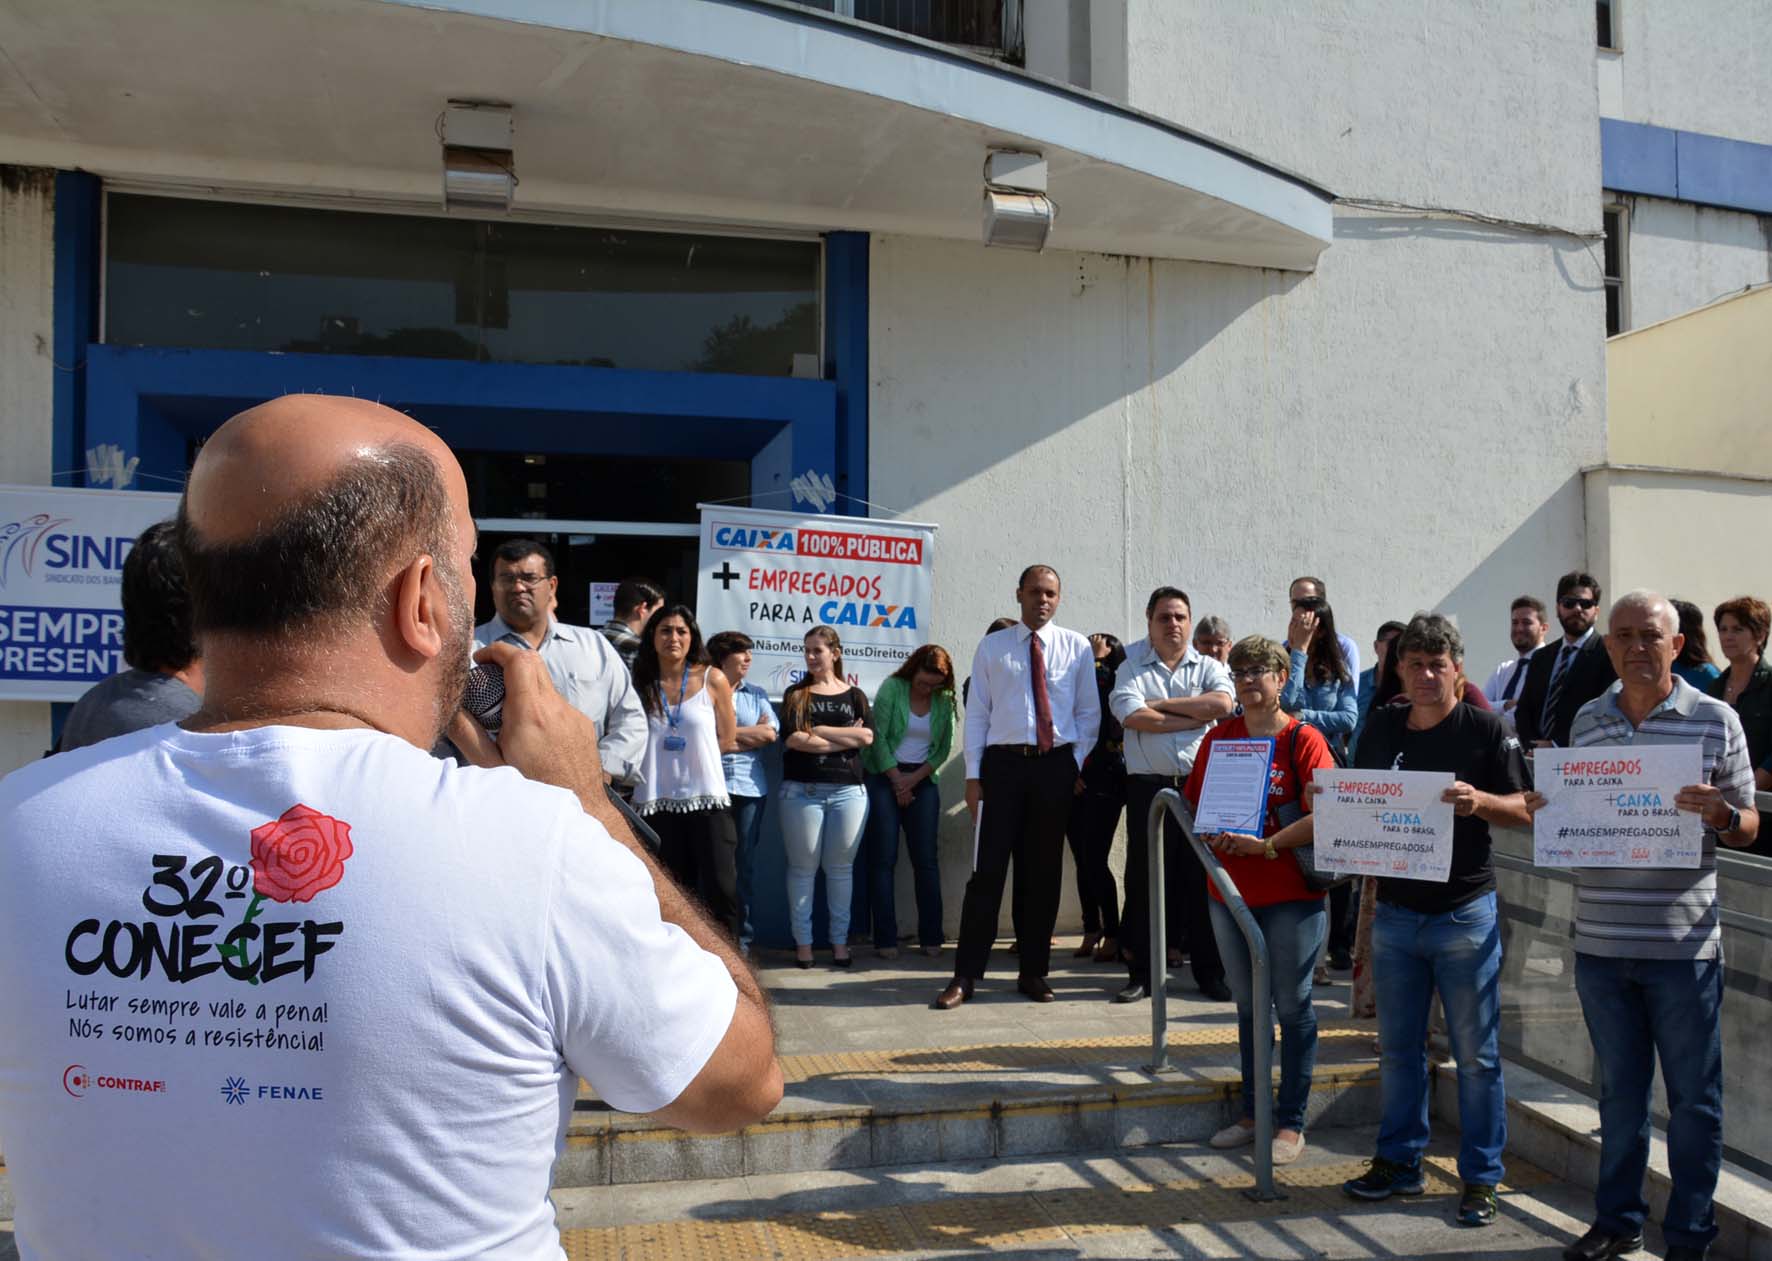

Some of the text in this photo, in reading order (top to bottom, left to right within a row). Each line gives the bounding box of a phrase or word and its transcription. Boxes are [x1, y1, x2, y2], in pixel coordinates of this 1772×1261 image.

[716, 527, 919, 561] CAIXA 100% PÚBLICA
[749, 568, 882, 600] EMPREGADOS
[750, 600, 918, 630] PARA A CAIXA
[0, 609, 124, 646] SEMPR
[0, 646, 124, 674] RESENT
[1564, 778, 1585, 787] PARA
[1597, 777, 1623, 786] CAIXA
[1337, 796, 1355, 804] PARA
[1364, 797, 1387, 805] CAIXA
[1618, 808, 1639, 817] PARA
[1652, 807, 1681, 817] BRASIL
[1383, 825, 1401, 833] PARA
[1411, 826, 1436, 836] BRASIL
[1557, 825, 1681, 839] #MAISEMPREGADOSJÁ
[1333, 837, 1434, 854] #MAISEMPREGADOSJÁ
[65, 918, 344, 984] CONECEF
[66, 989, 328, 1028] Lutar sempre vale a pena!
[69, 1018, 324, 1051] Nós somos a resistência!
[97, 1076, 161, 1092] CONTRAF
[258, 1085, 323, 1101] FENAE
